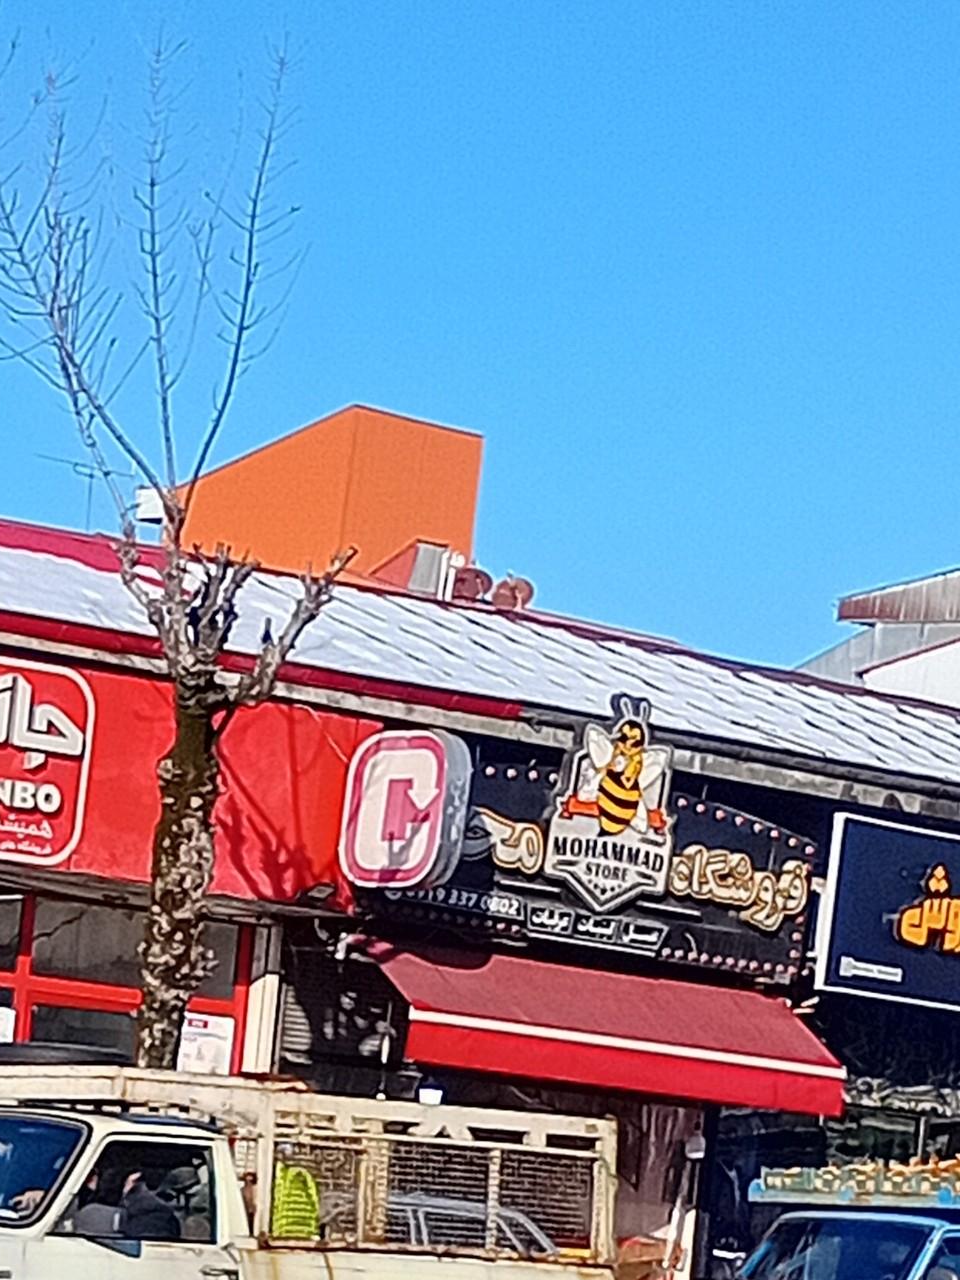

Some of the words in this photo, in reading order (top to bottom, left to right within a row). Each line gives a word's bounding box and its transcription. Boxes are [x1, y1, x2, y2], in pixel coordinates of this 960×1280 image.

[552, 835, 665, 874] MOHAMMAD
[585, 861, 630, 883] STORE
[669, 845, 809, 931] فروشگاه
